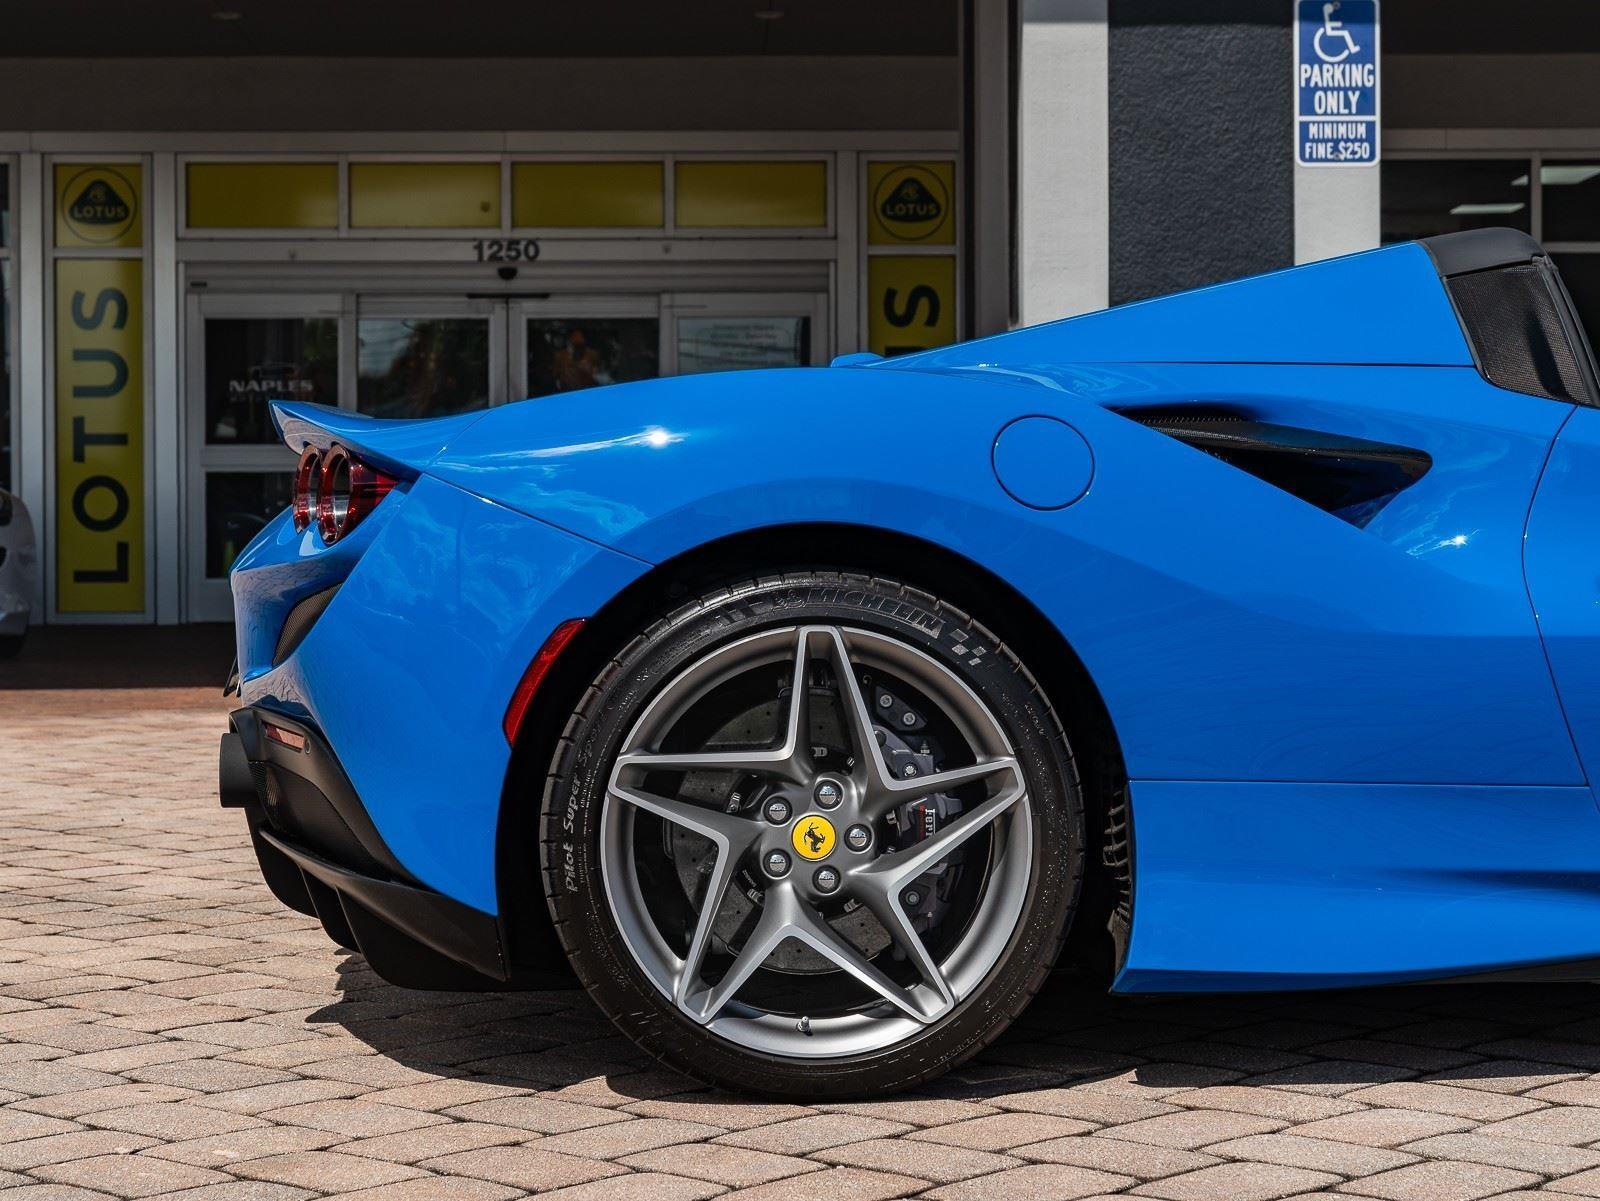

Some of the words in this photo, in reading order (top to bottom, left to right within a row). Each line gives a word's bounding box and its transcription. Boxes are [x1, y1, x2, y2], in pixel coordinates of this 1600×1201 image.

[1300, 64, 1374, 87] PARKING
[1314, 91, 1360, 114] ONLY
[1309, 123, 1366, 139] MINIMUM
[1305, 143, 1334, 159] FINE
[1338, 141, 1369, 161] $250
[74, 205, 126, 218] LOTUS
[886, 203, 937, 215] LOTUS
[473, 240, 540, 261] 1250
[229, 380, 314, 392] NAPLES
[72, 288, 129, 583] LOTUS
[803, 588, 944, 638] MICHELIN
[563, 774, 582, 833] Super
[925, 808, 935, 837] Ferr
[563, 841, 578, 892] Pilot
